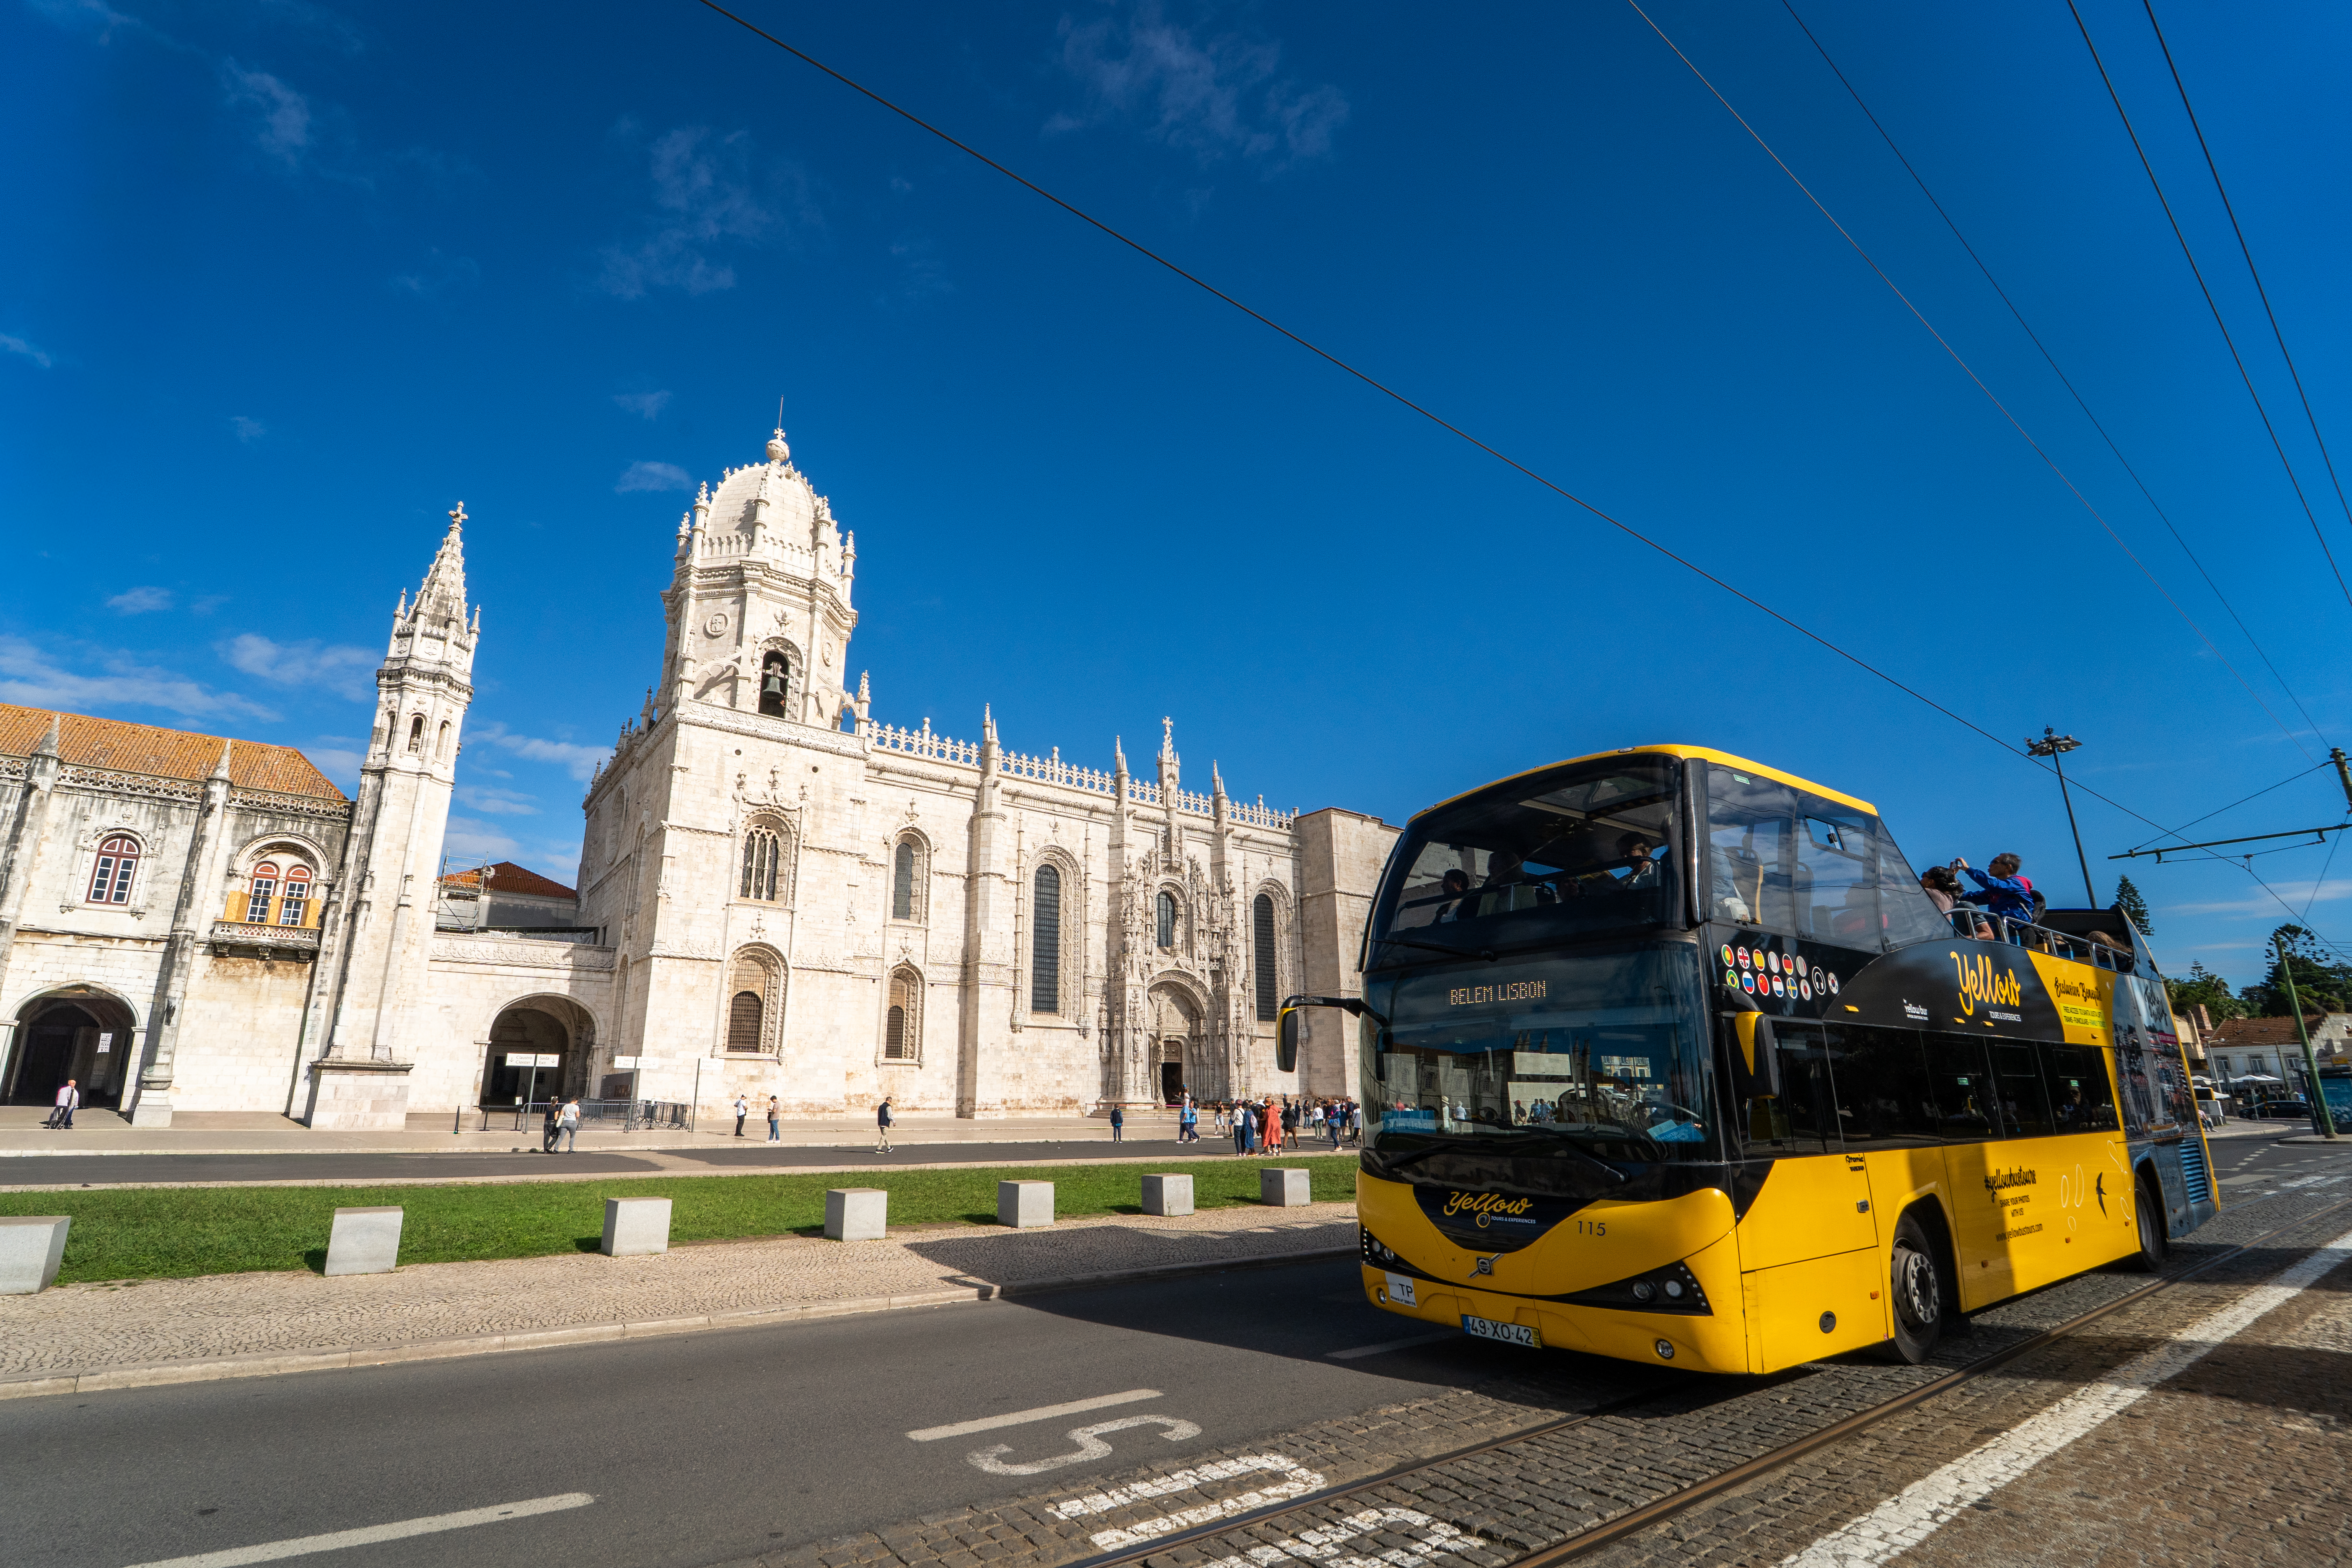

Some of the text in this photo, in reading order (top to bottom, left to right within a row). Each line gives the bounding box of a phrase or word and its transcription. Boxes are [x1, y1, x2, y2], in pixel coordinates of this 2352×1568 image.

[1451, 980, 1546, 1005] BELEM LISBON
[1950, 951, 2021, 1016] Yellow
[2054, 977, 2102, 1006] Exclusive Benefits
[2002, 1013, 2021, 1021] EXPERIENCES
[1984, 1165, 2036, 1203] #yellowbustours
[1444, 1192, 1533, 1216] Yellow
[2000, 1195, 2030, 1208] SHARE YOUR PHOTOS
[2010, 1208, 2019, 1217] WITH
[1577, 1221, 1606, 1236] 115
[1995, 1223, 2043, 1242] www.yellowbustours.com
[1398, 1283, 1413, 1297] TP
